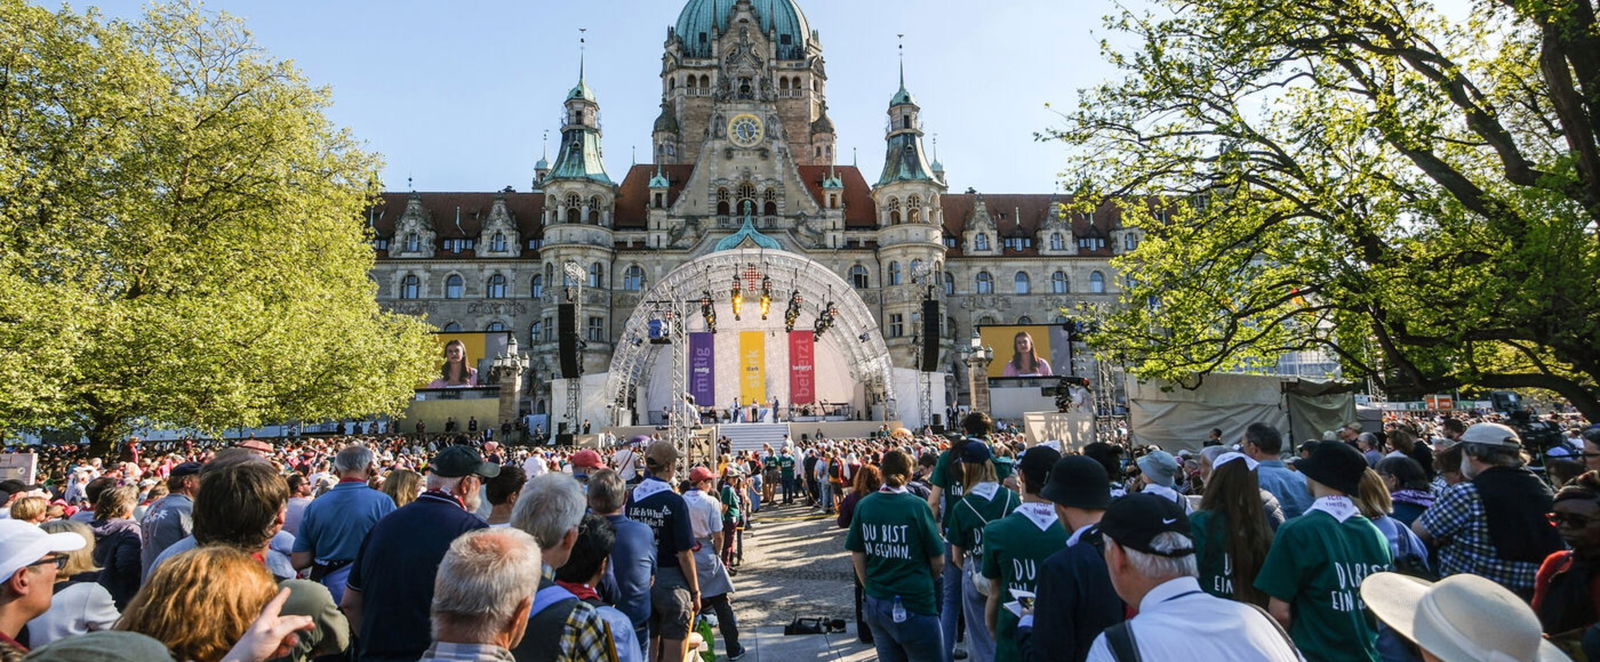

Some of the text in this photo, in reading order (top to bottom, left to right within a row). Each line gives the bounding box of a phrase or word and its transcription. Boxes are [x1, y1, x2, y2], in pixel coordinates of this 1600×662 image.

[694, 347, 710, 392] mutig
[795, 339, 810, 397] beherzt
[862, 523, 909, 543] DU BIST
[1013, 558, 1037, 581] DU
[1331, 589, 1354, 612] EIN
